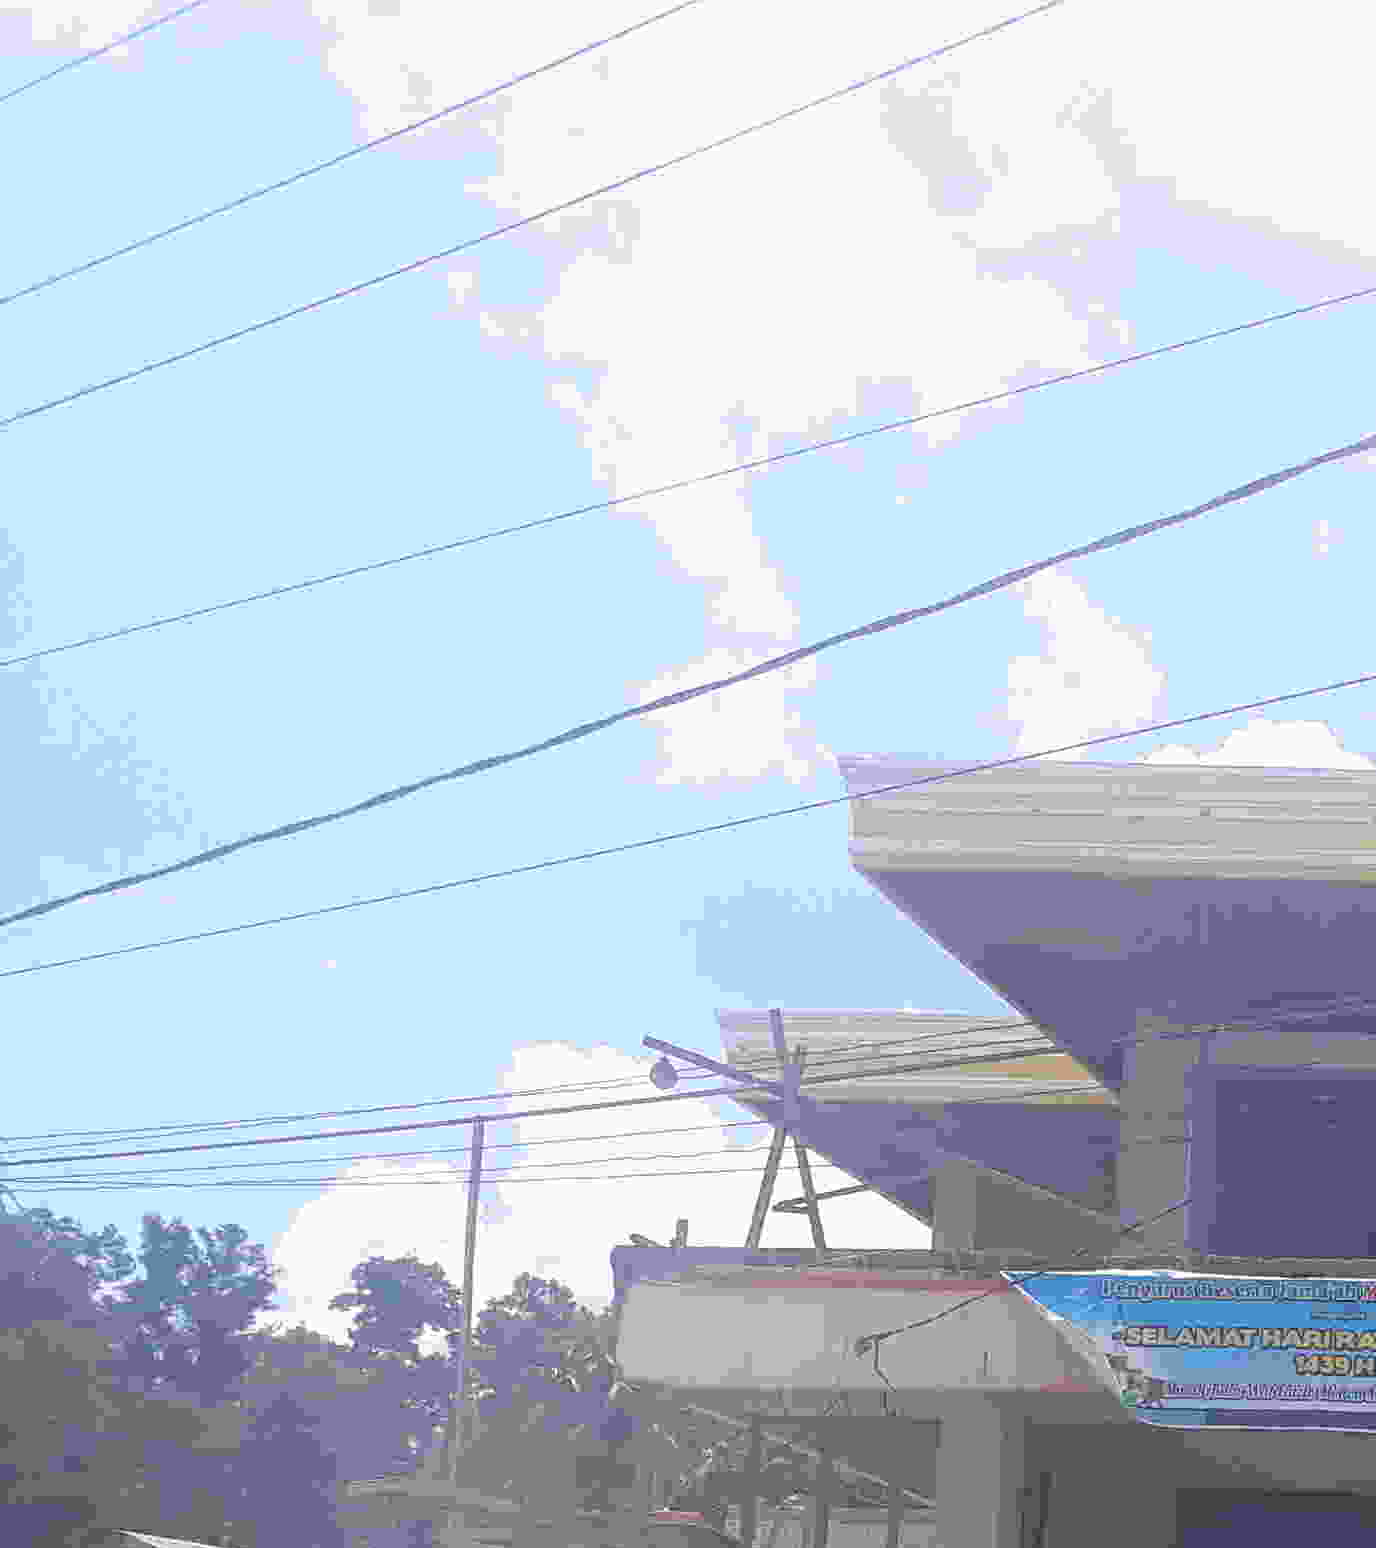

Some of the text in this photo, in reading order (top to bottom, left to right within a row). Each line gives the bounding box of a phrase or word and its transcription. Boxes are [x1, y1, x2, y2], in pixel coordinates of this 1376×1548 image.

[1122, 1327, 1252, 1349] SELAMAT
[1260, 1328, 1333, 1352] HARI
[1295, 1353, 1376, 1377] 1439 H
